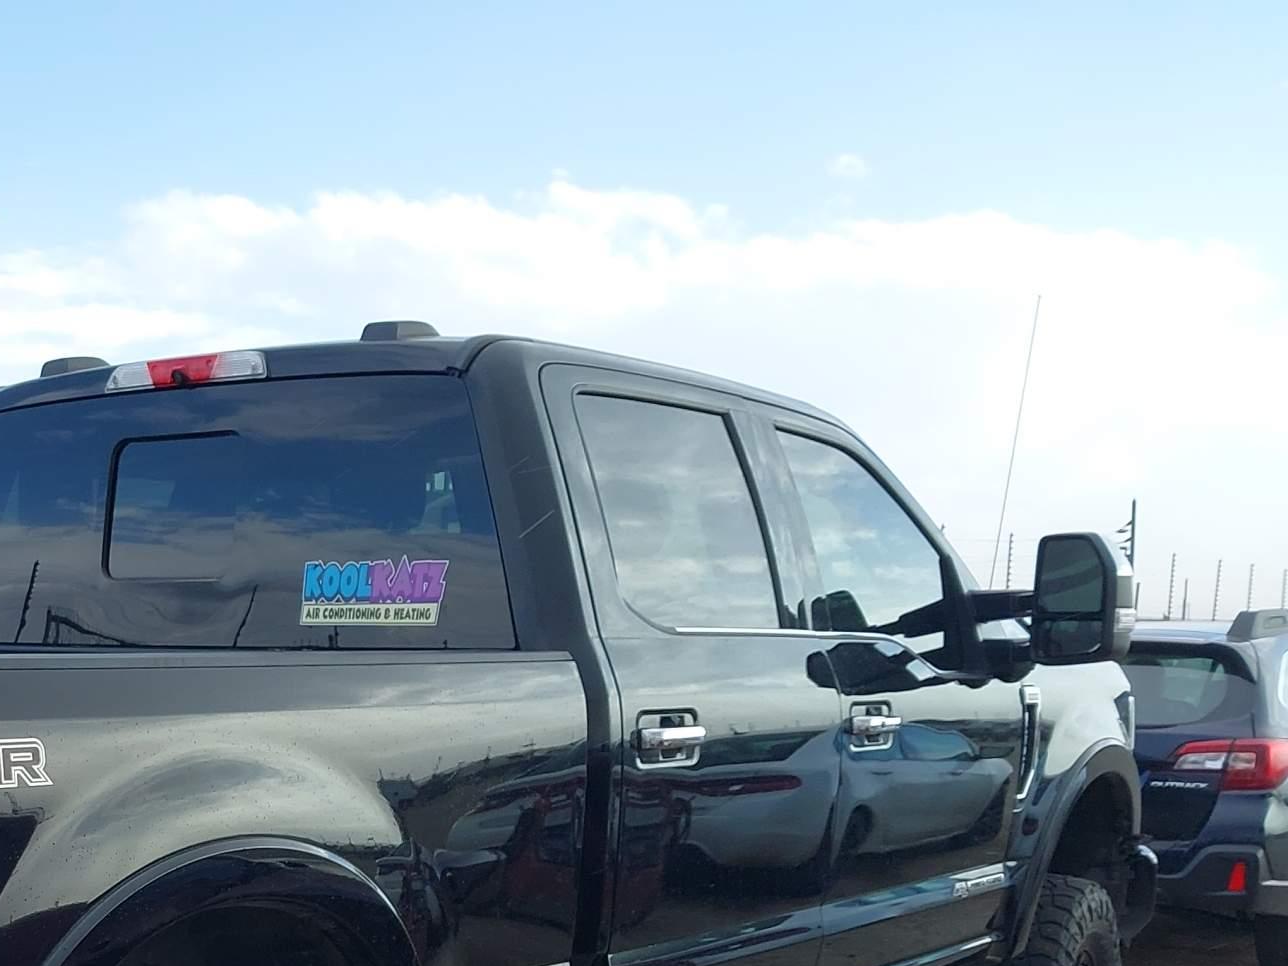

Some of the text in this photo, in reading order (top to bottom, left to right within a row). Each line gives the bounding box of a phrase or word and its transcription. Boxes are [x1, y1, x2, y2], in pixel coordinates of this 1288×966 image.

[305, 607, 432, 620] AIR CONDITIONING & HEATING
